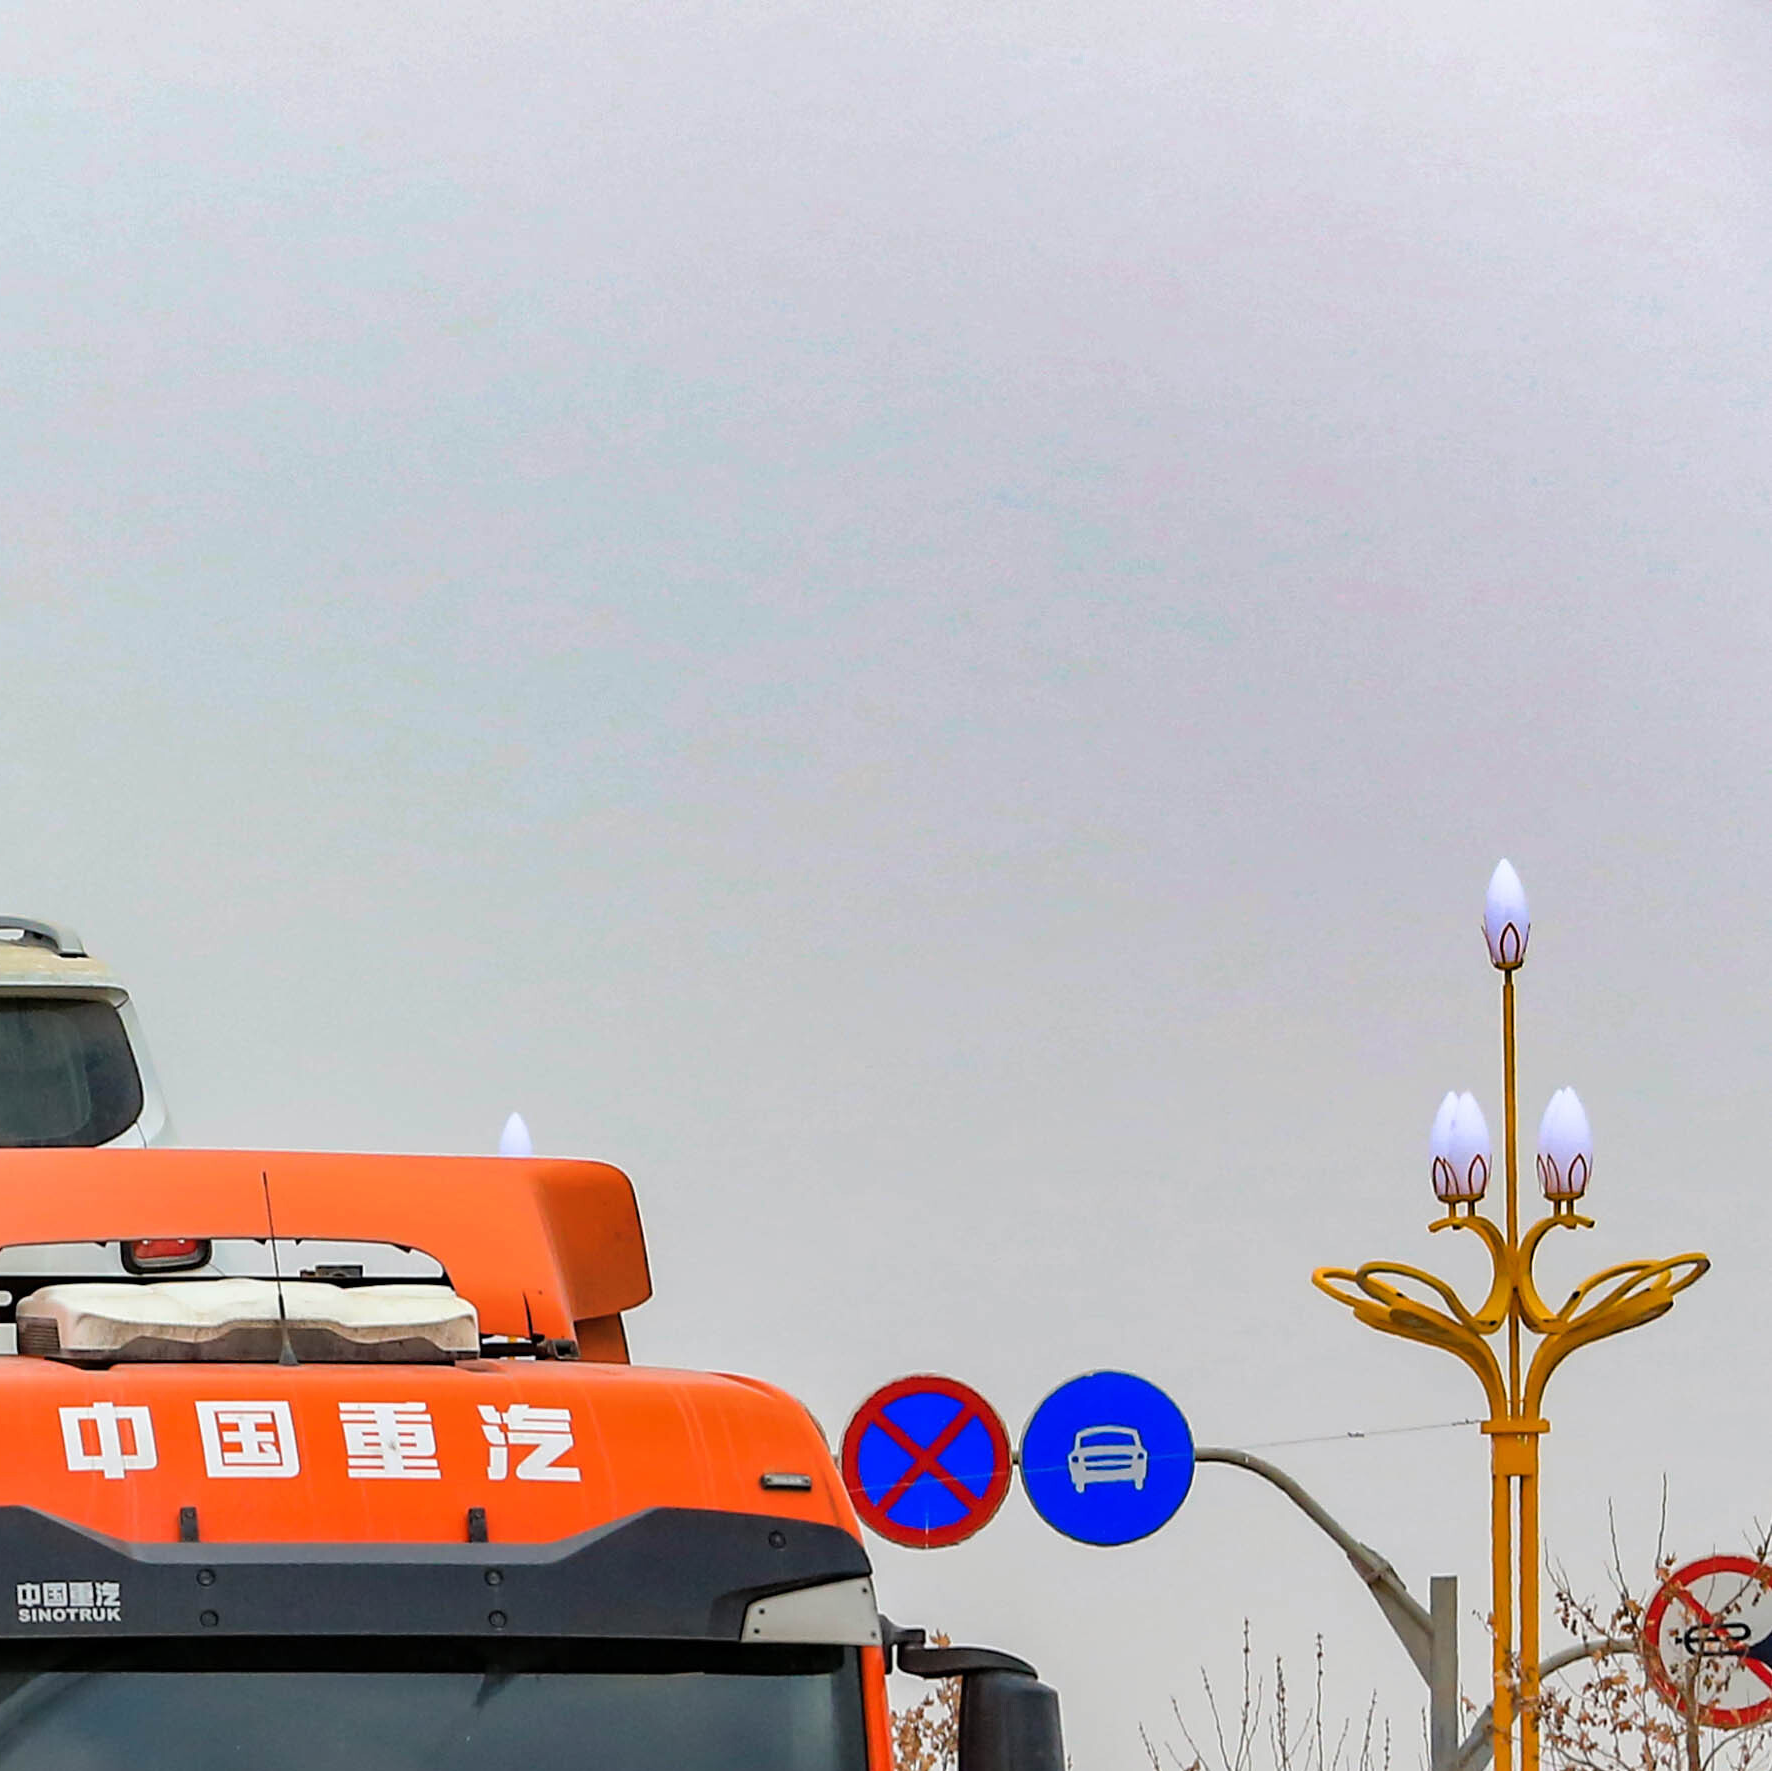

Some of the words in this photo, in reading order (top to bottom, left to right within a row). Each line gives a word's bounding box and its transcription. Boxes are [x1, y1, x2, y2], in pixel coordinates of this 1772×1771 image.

[59, 1400, 581, 1482] 中国重汽
[16, 1582, 121, 1607] 中国重汽
[18, 1607, 122, 1622] SINOTRUK
